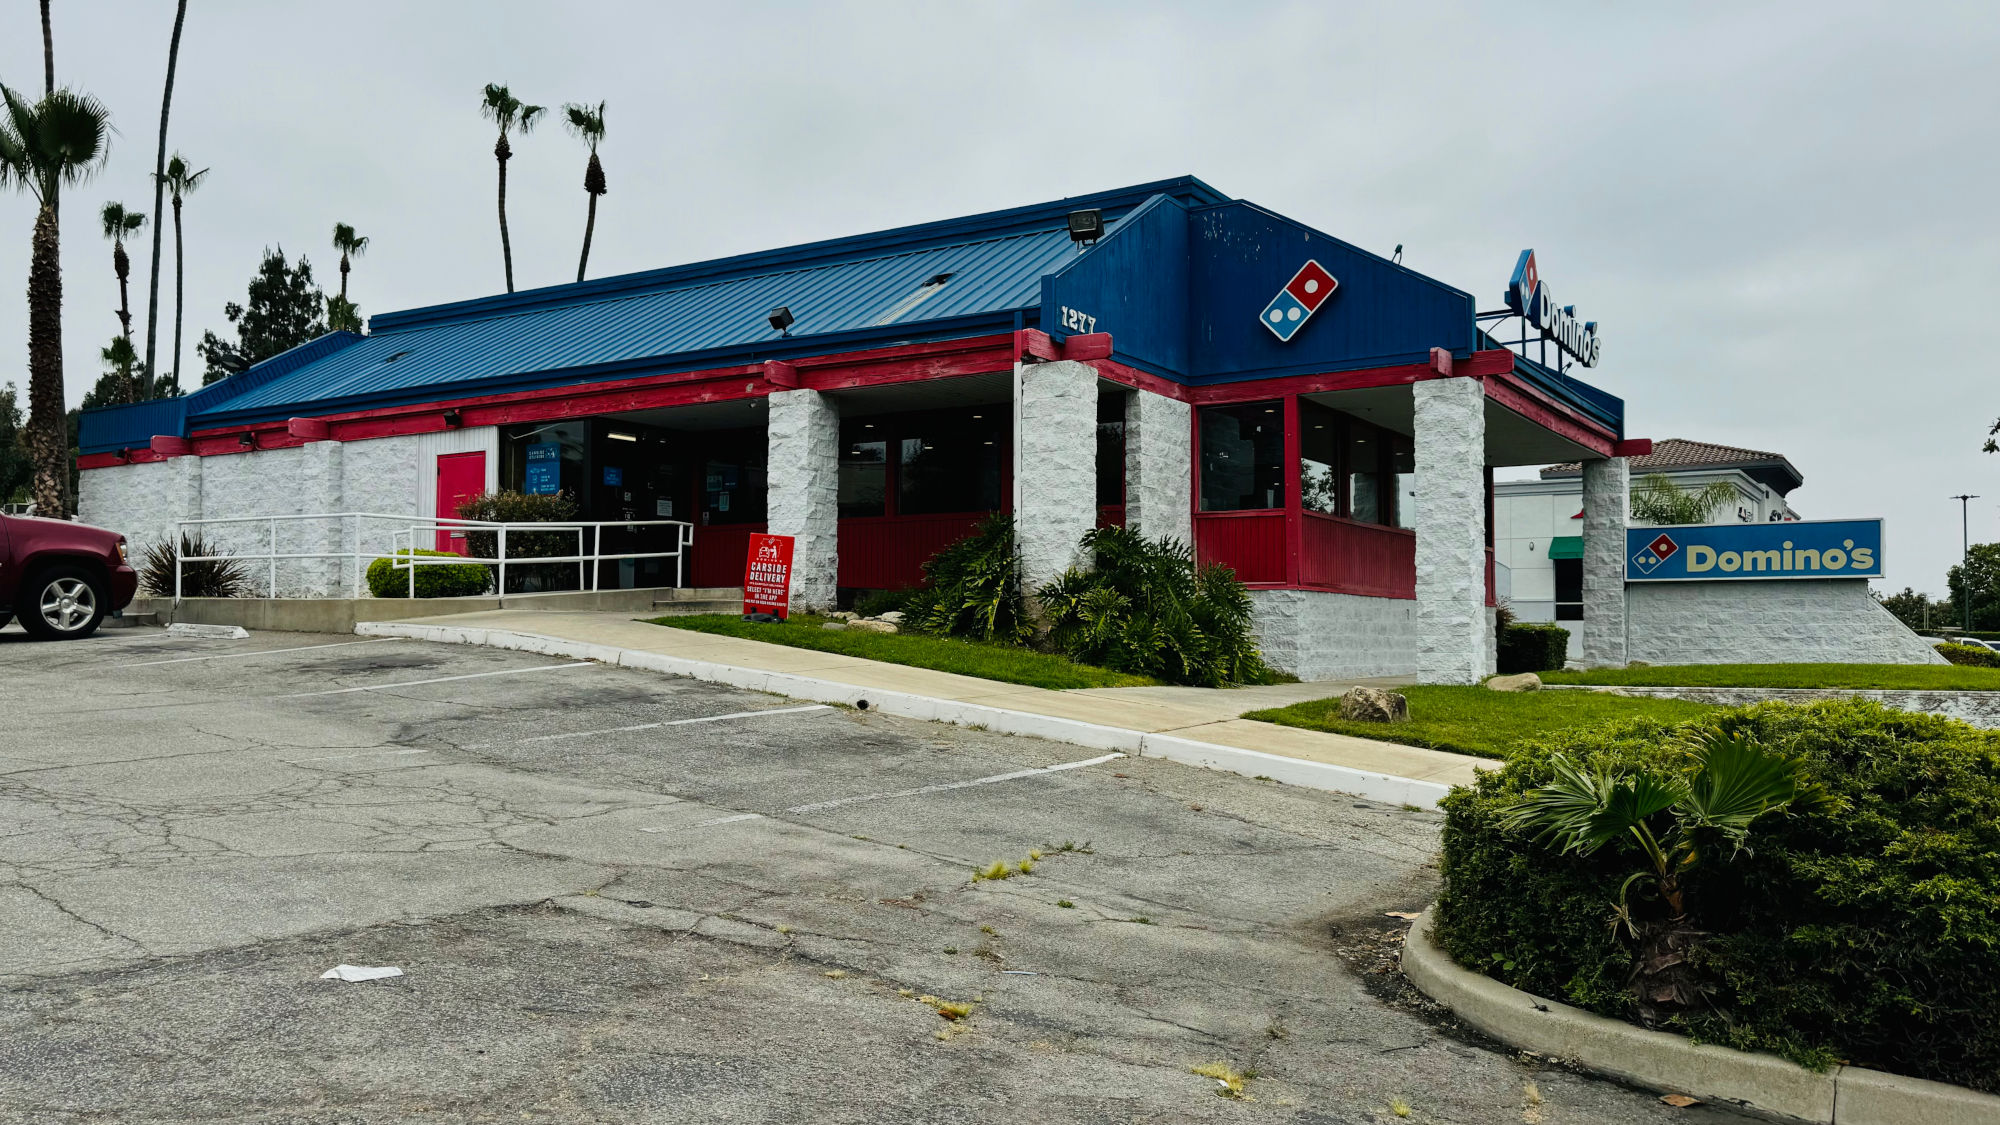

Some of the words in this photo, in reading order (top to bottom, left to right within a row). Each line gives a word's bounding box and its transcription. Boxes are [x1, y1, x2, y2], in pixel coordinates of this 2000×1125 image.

[1061, 305, 1097, 335] 1277
[1539, 279, 1601, 369] Domino's
[751, 562, 787, 574] CARSIDE
[1686, 538, 1875, 573] Domino's
[749, 571, 785, 583] DELIVERY
